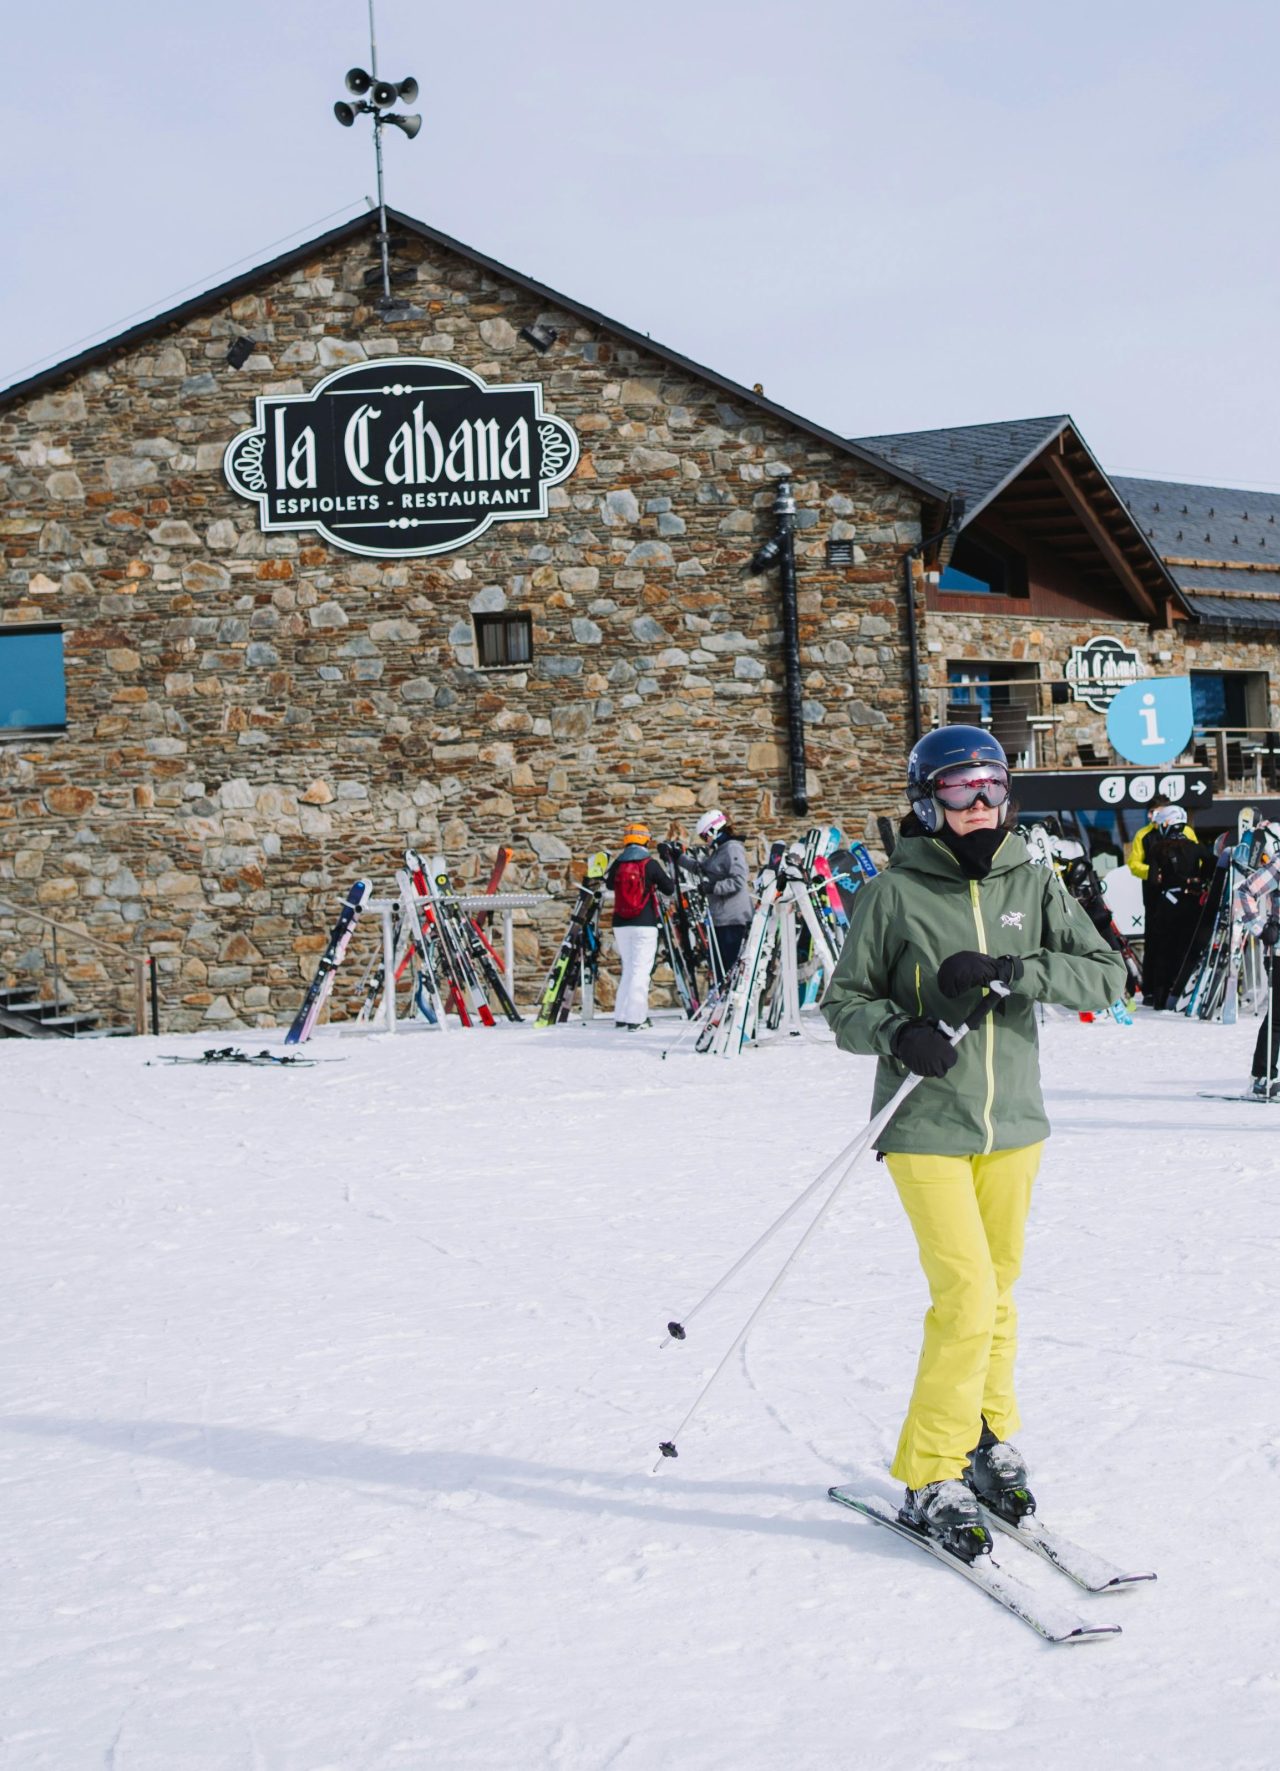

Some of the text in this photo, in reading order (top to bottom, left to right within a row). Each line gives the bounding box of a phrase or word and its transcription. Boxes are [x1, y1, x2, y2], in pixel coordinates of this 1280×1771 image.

[275, 400, 531, 490] la Cabana
[276, 495, 380, 514] ESPIOLETS
[402, 488, 531, 509] RESTAURANT
